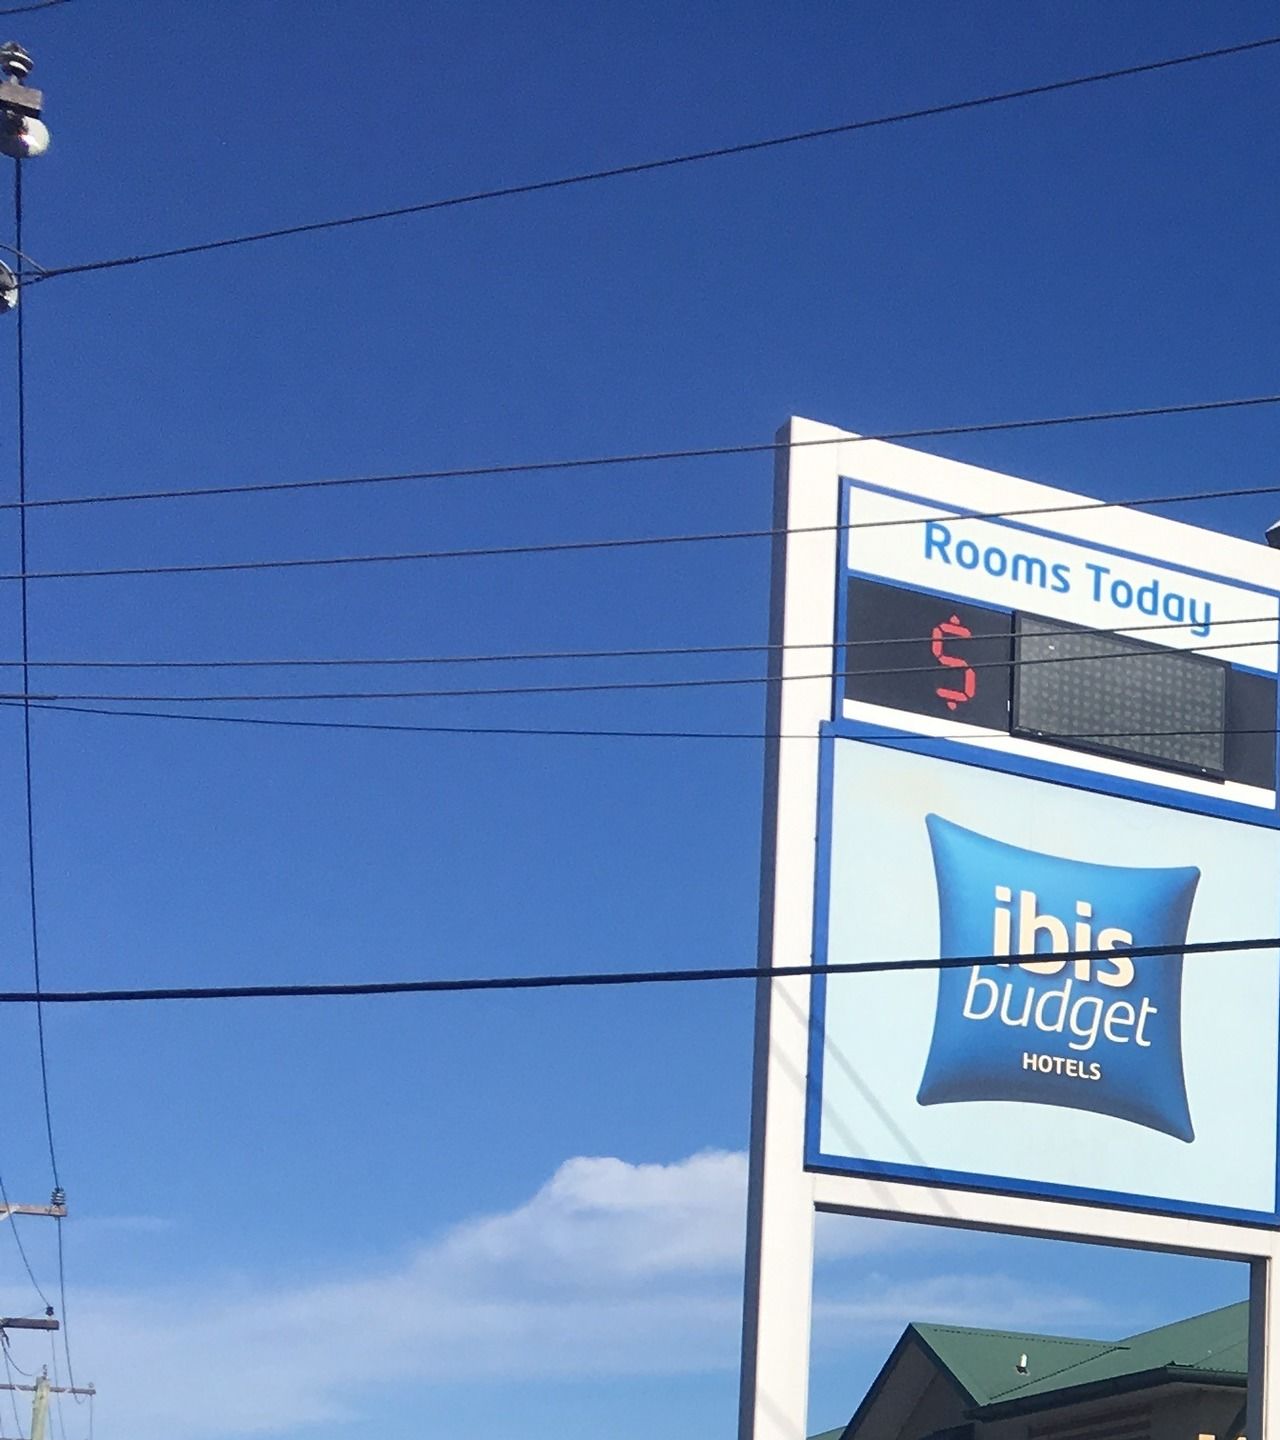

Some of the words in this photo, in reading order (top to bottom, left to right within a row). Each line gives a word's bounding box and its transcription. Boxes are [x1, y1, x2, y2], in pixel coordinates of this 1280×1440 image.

[924, 521, 1070, 593] Rooms
[1085, 563, 1211, 637] Today
[993, 885, 1135, 987] ibis
[963, 964, 1157, 1050] budget
[1023, 1052, 1101, 1080] HOTELS
